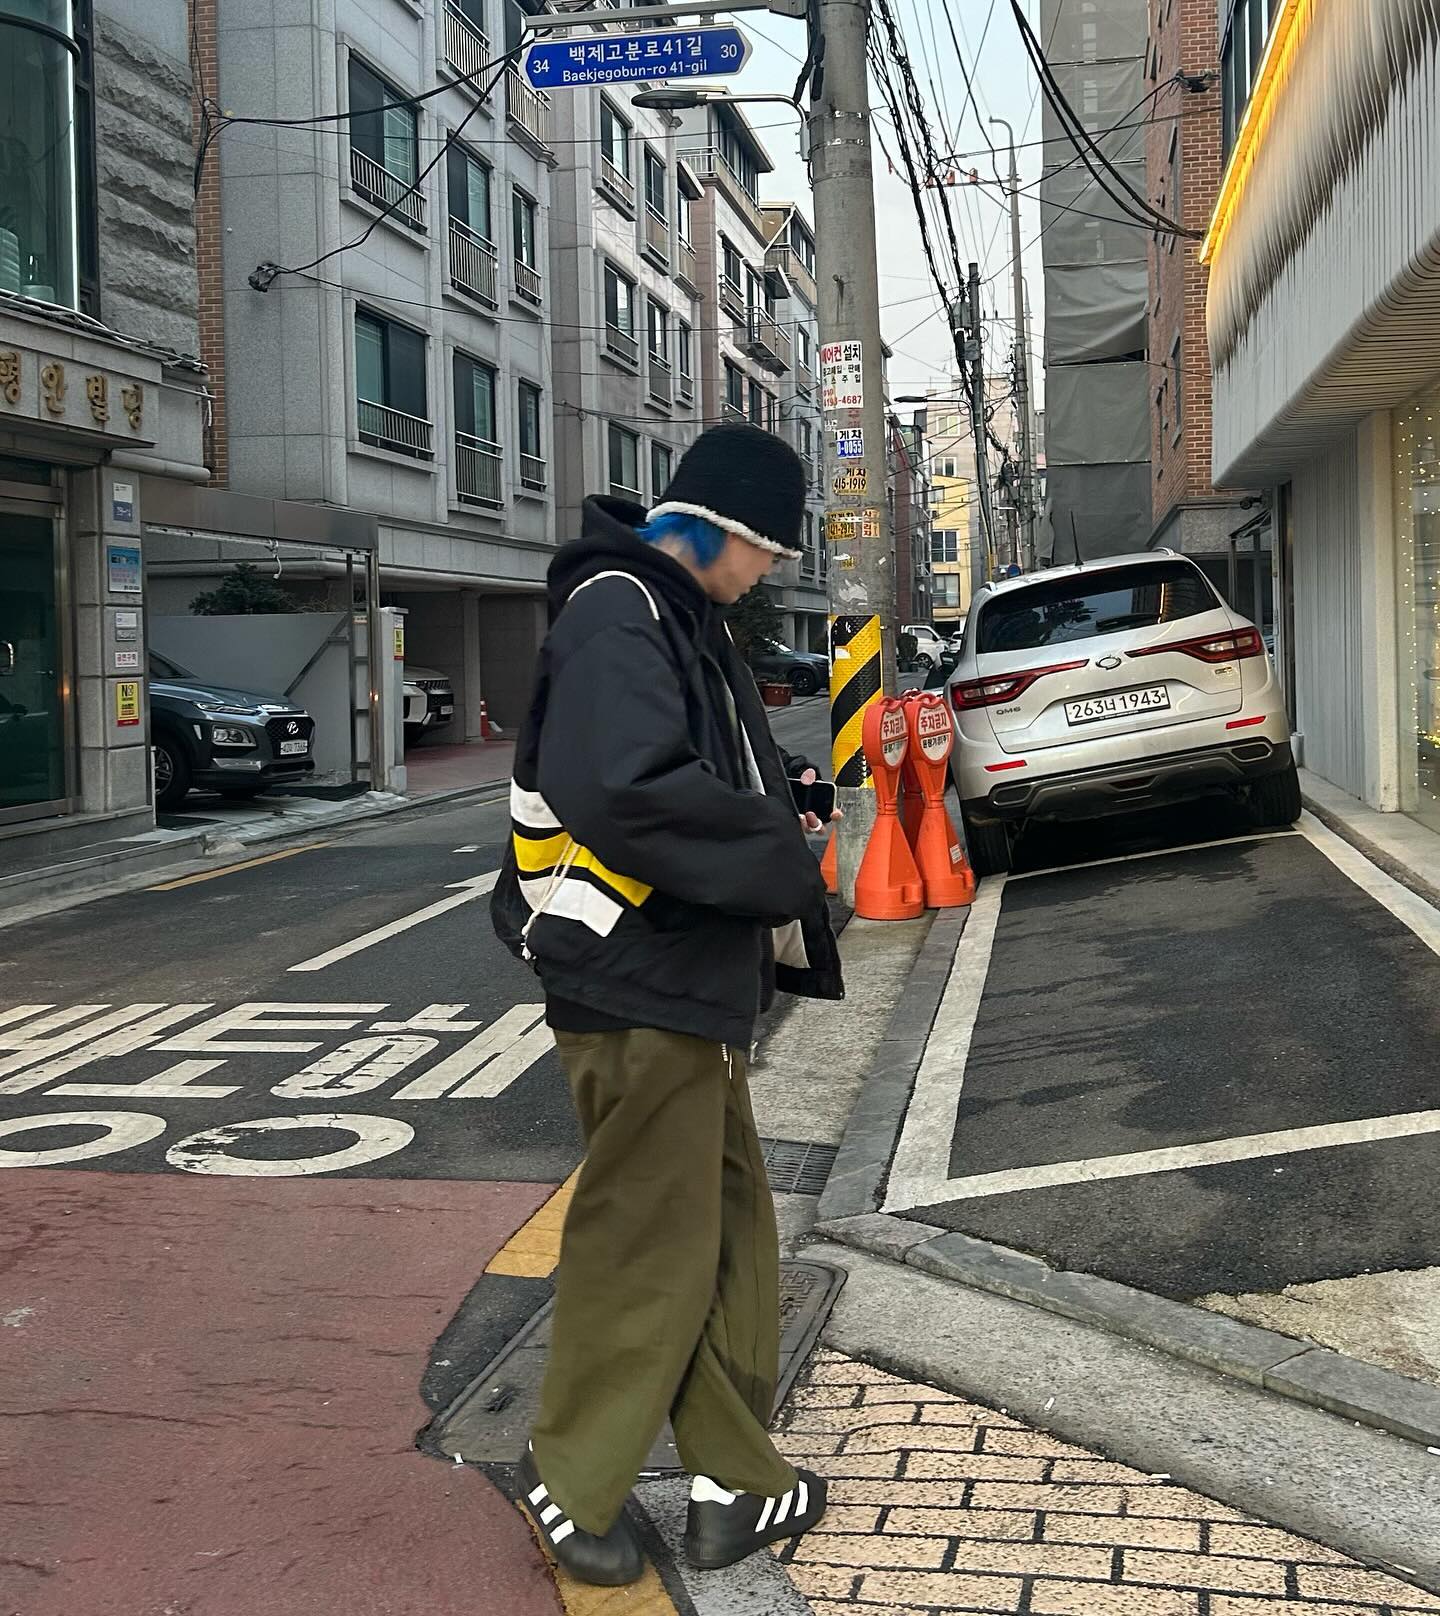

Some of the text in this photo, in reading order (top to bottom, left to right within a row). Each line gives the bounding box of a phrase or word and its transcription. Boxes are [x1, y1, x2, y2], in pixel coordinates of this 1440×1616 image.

[569, 36, 703, 65] 백제고분로41길
[720, 44, 738, 58] 30
[533, 60, 550, 74] 34
[562, 59, 707, 83] Baekjegobun-ro 41-gil
[843, 344, 861, 361] 설치
[1072, 690, 1162, 719] 263너 1943
[883, 716, 904, 737] 주차금지
[920, 712, 947, 732] 주차금지
